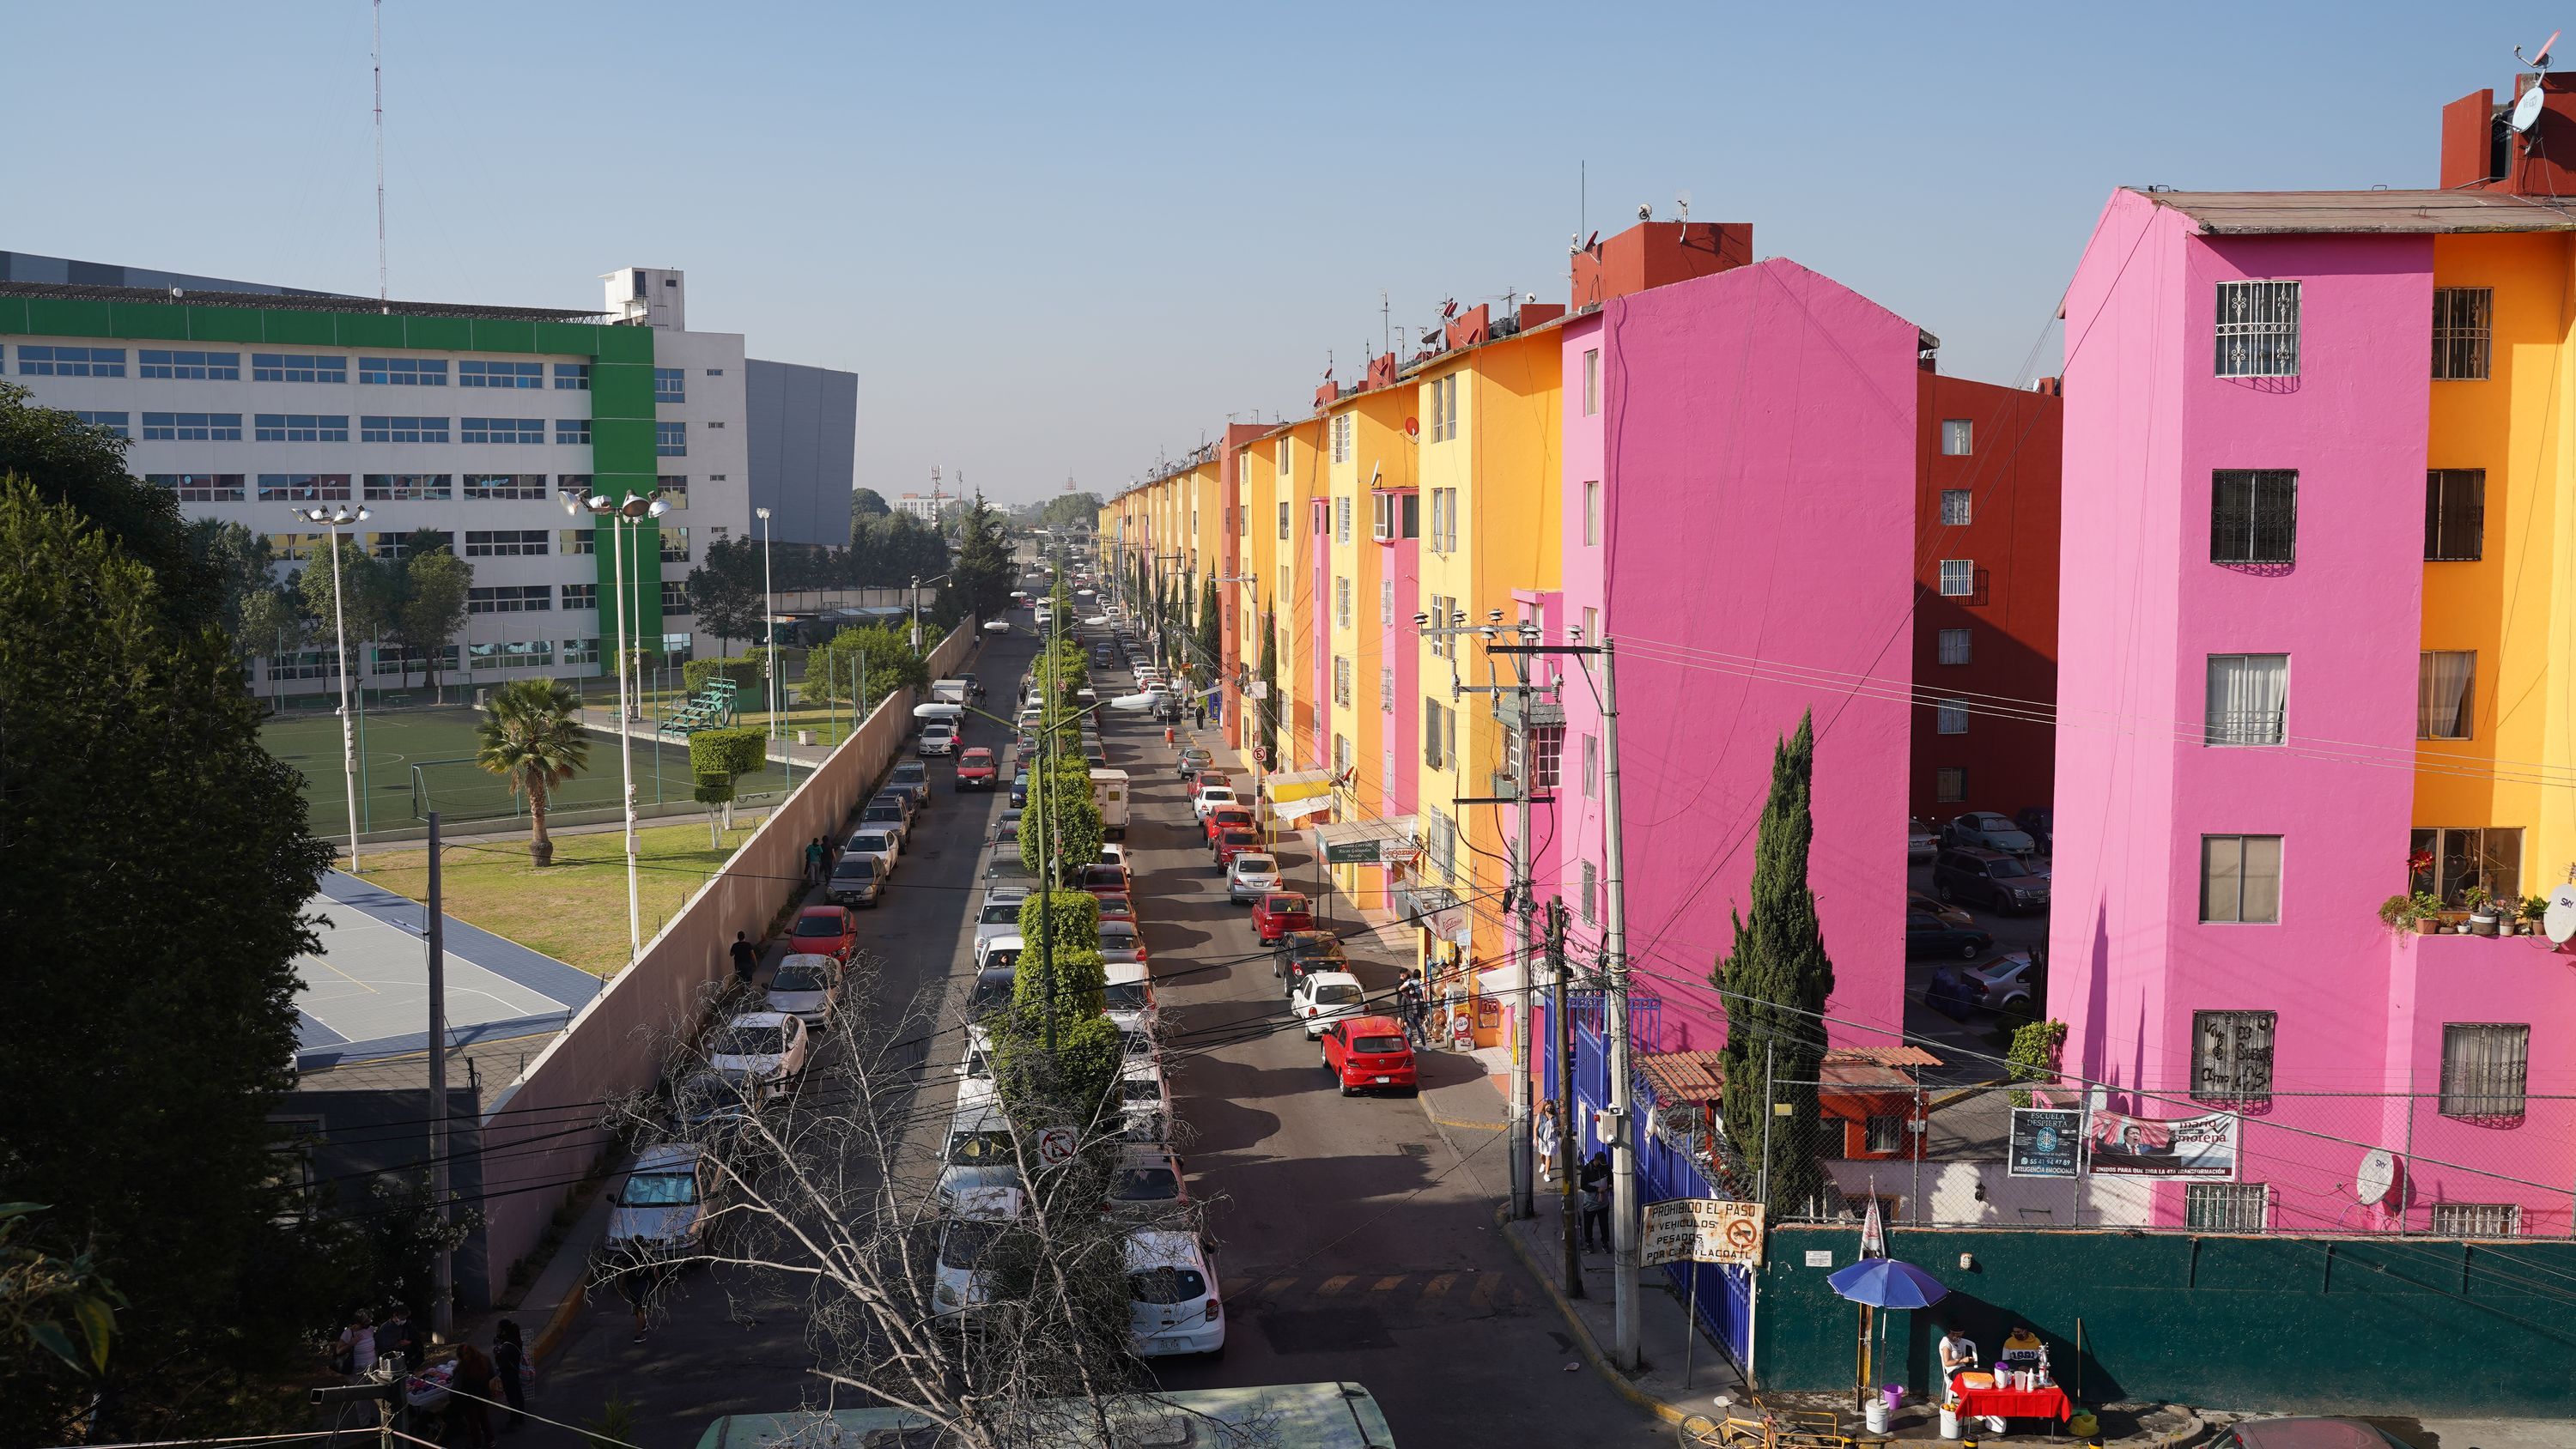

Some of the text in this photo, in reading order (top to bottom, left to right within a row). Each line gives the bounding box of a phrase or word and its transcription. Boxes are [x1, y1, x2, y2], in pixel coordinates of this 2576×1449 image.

[2561, 897, 2574, 908] SKY
[2179, 1119, 2216, 1128] mario
[2178, 1134, 2227, 1143] morena
[1652, 1202, 1756, 1218] PROHIBIDO EL PASO
[1659, 1220, 1716, 1231] VEHICULOS
[1656, 1234, 1703, 1244] PESADOS
[1647, 1251, 1666, 1260] POR
